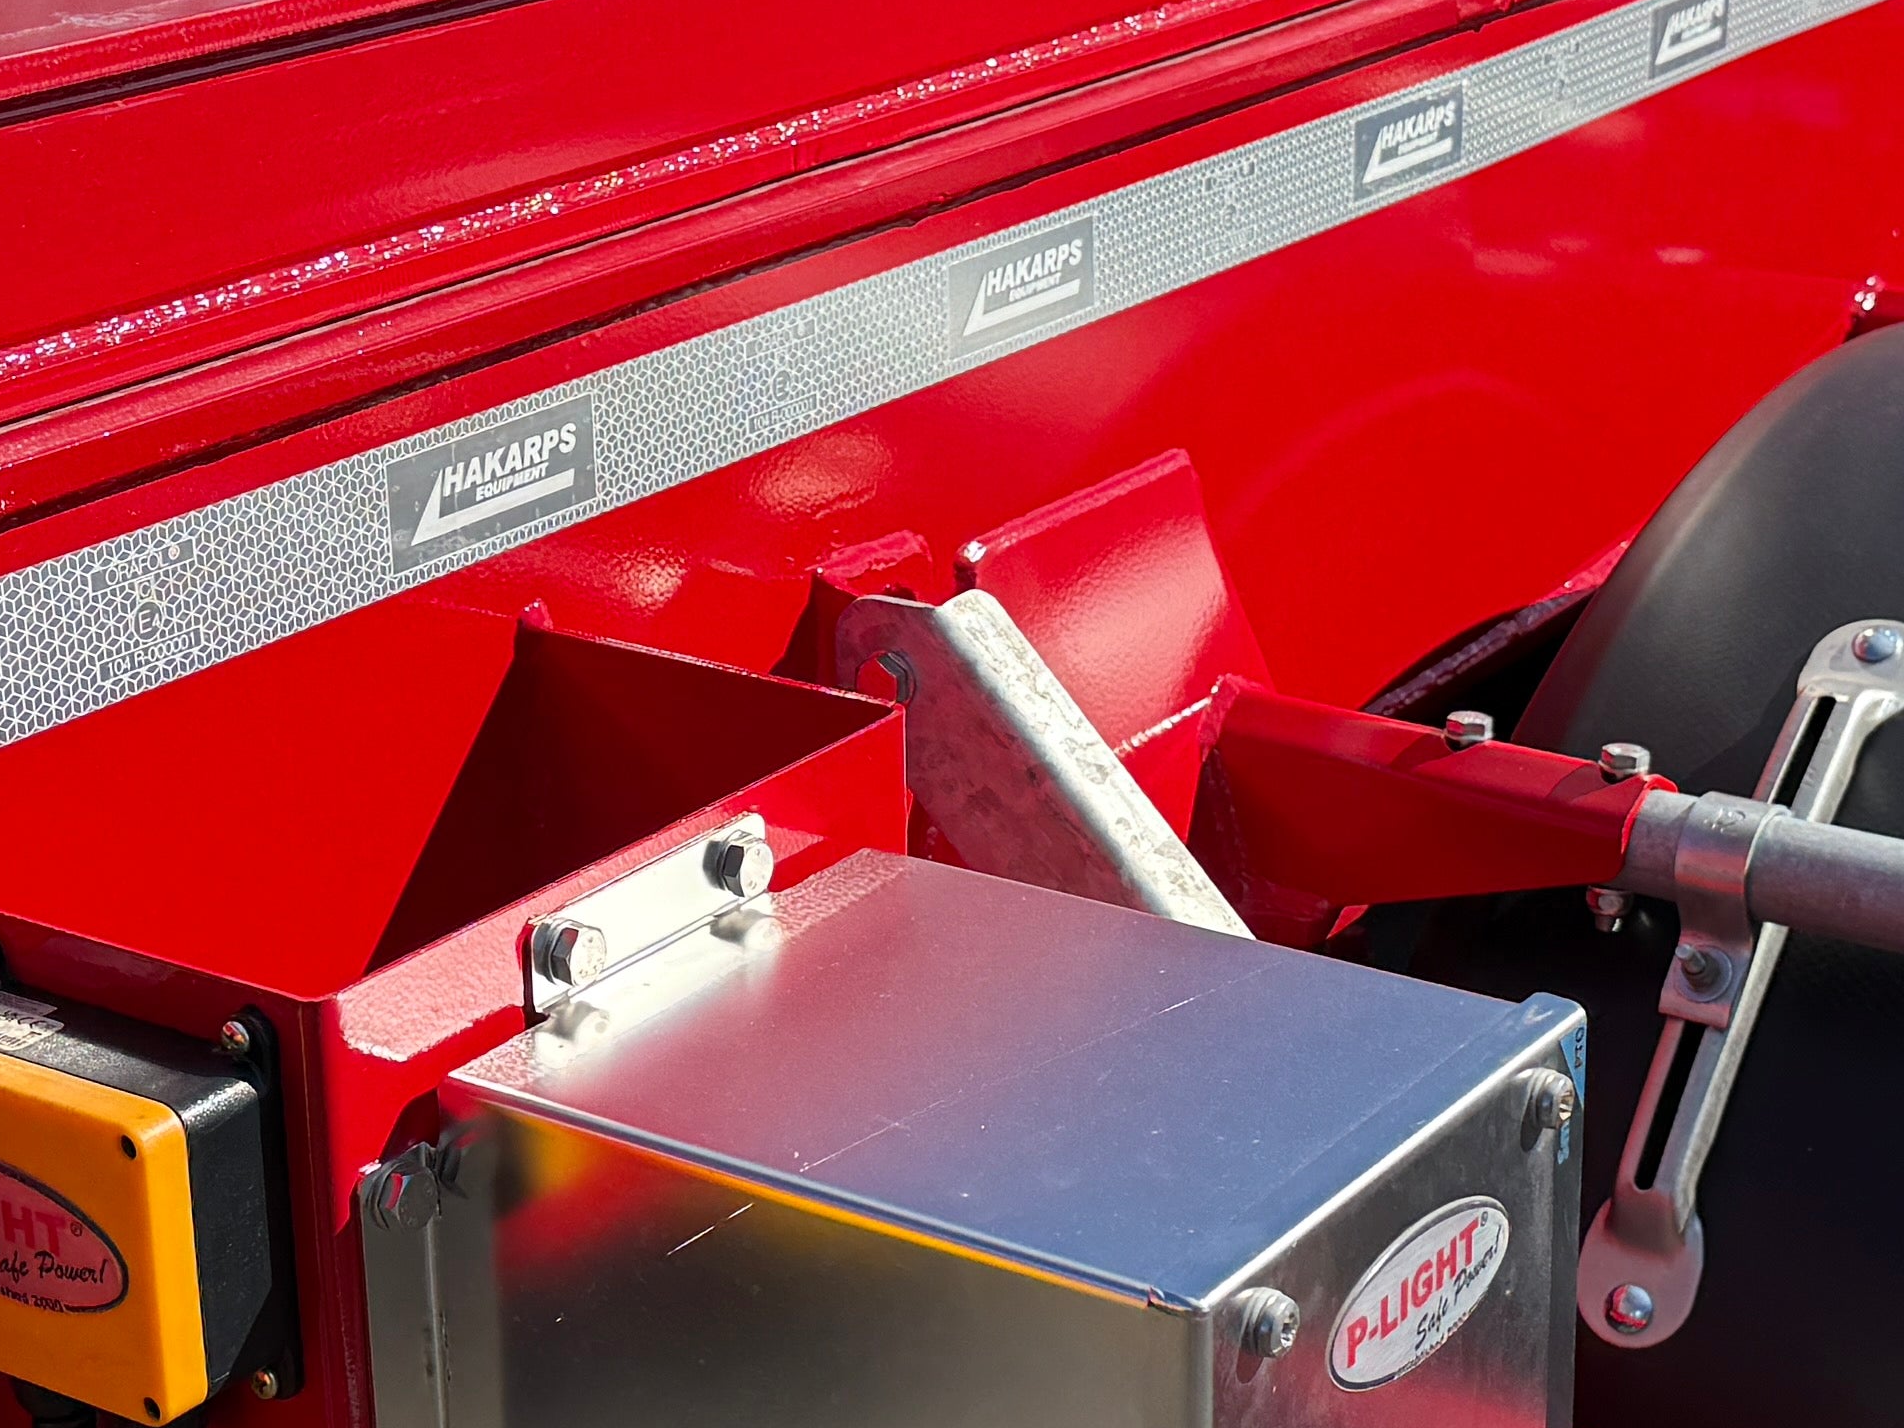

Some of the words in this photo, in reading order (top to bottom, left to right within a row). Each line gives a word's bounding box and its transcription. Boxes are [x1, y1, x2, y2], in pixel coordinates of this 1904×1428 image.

[1381, 100, 1457, 150] HAKARPS
[986, 238, 1083, 297] HAKARPS
[442, 422, 577, 498] HAKARPS
[475, 461, 549, 502] EQUIPMENT
[107, 655, 131, 677] 104
[134, 631, 195, 668] R-000001
[33, 1250, 110, 1285] Power!
[1414, 1294, 1449, 1352] Safe
